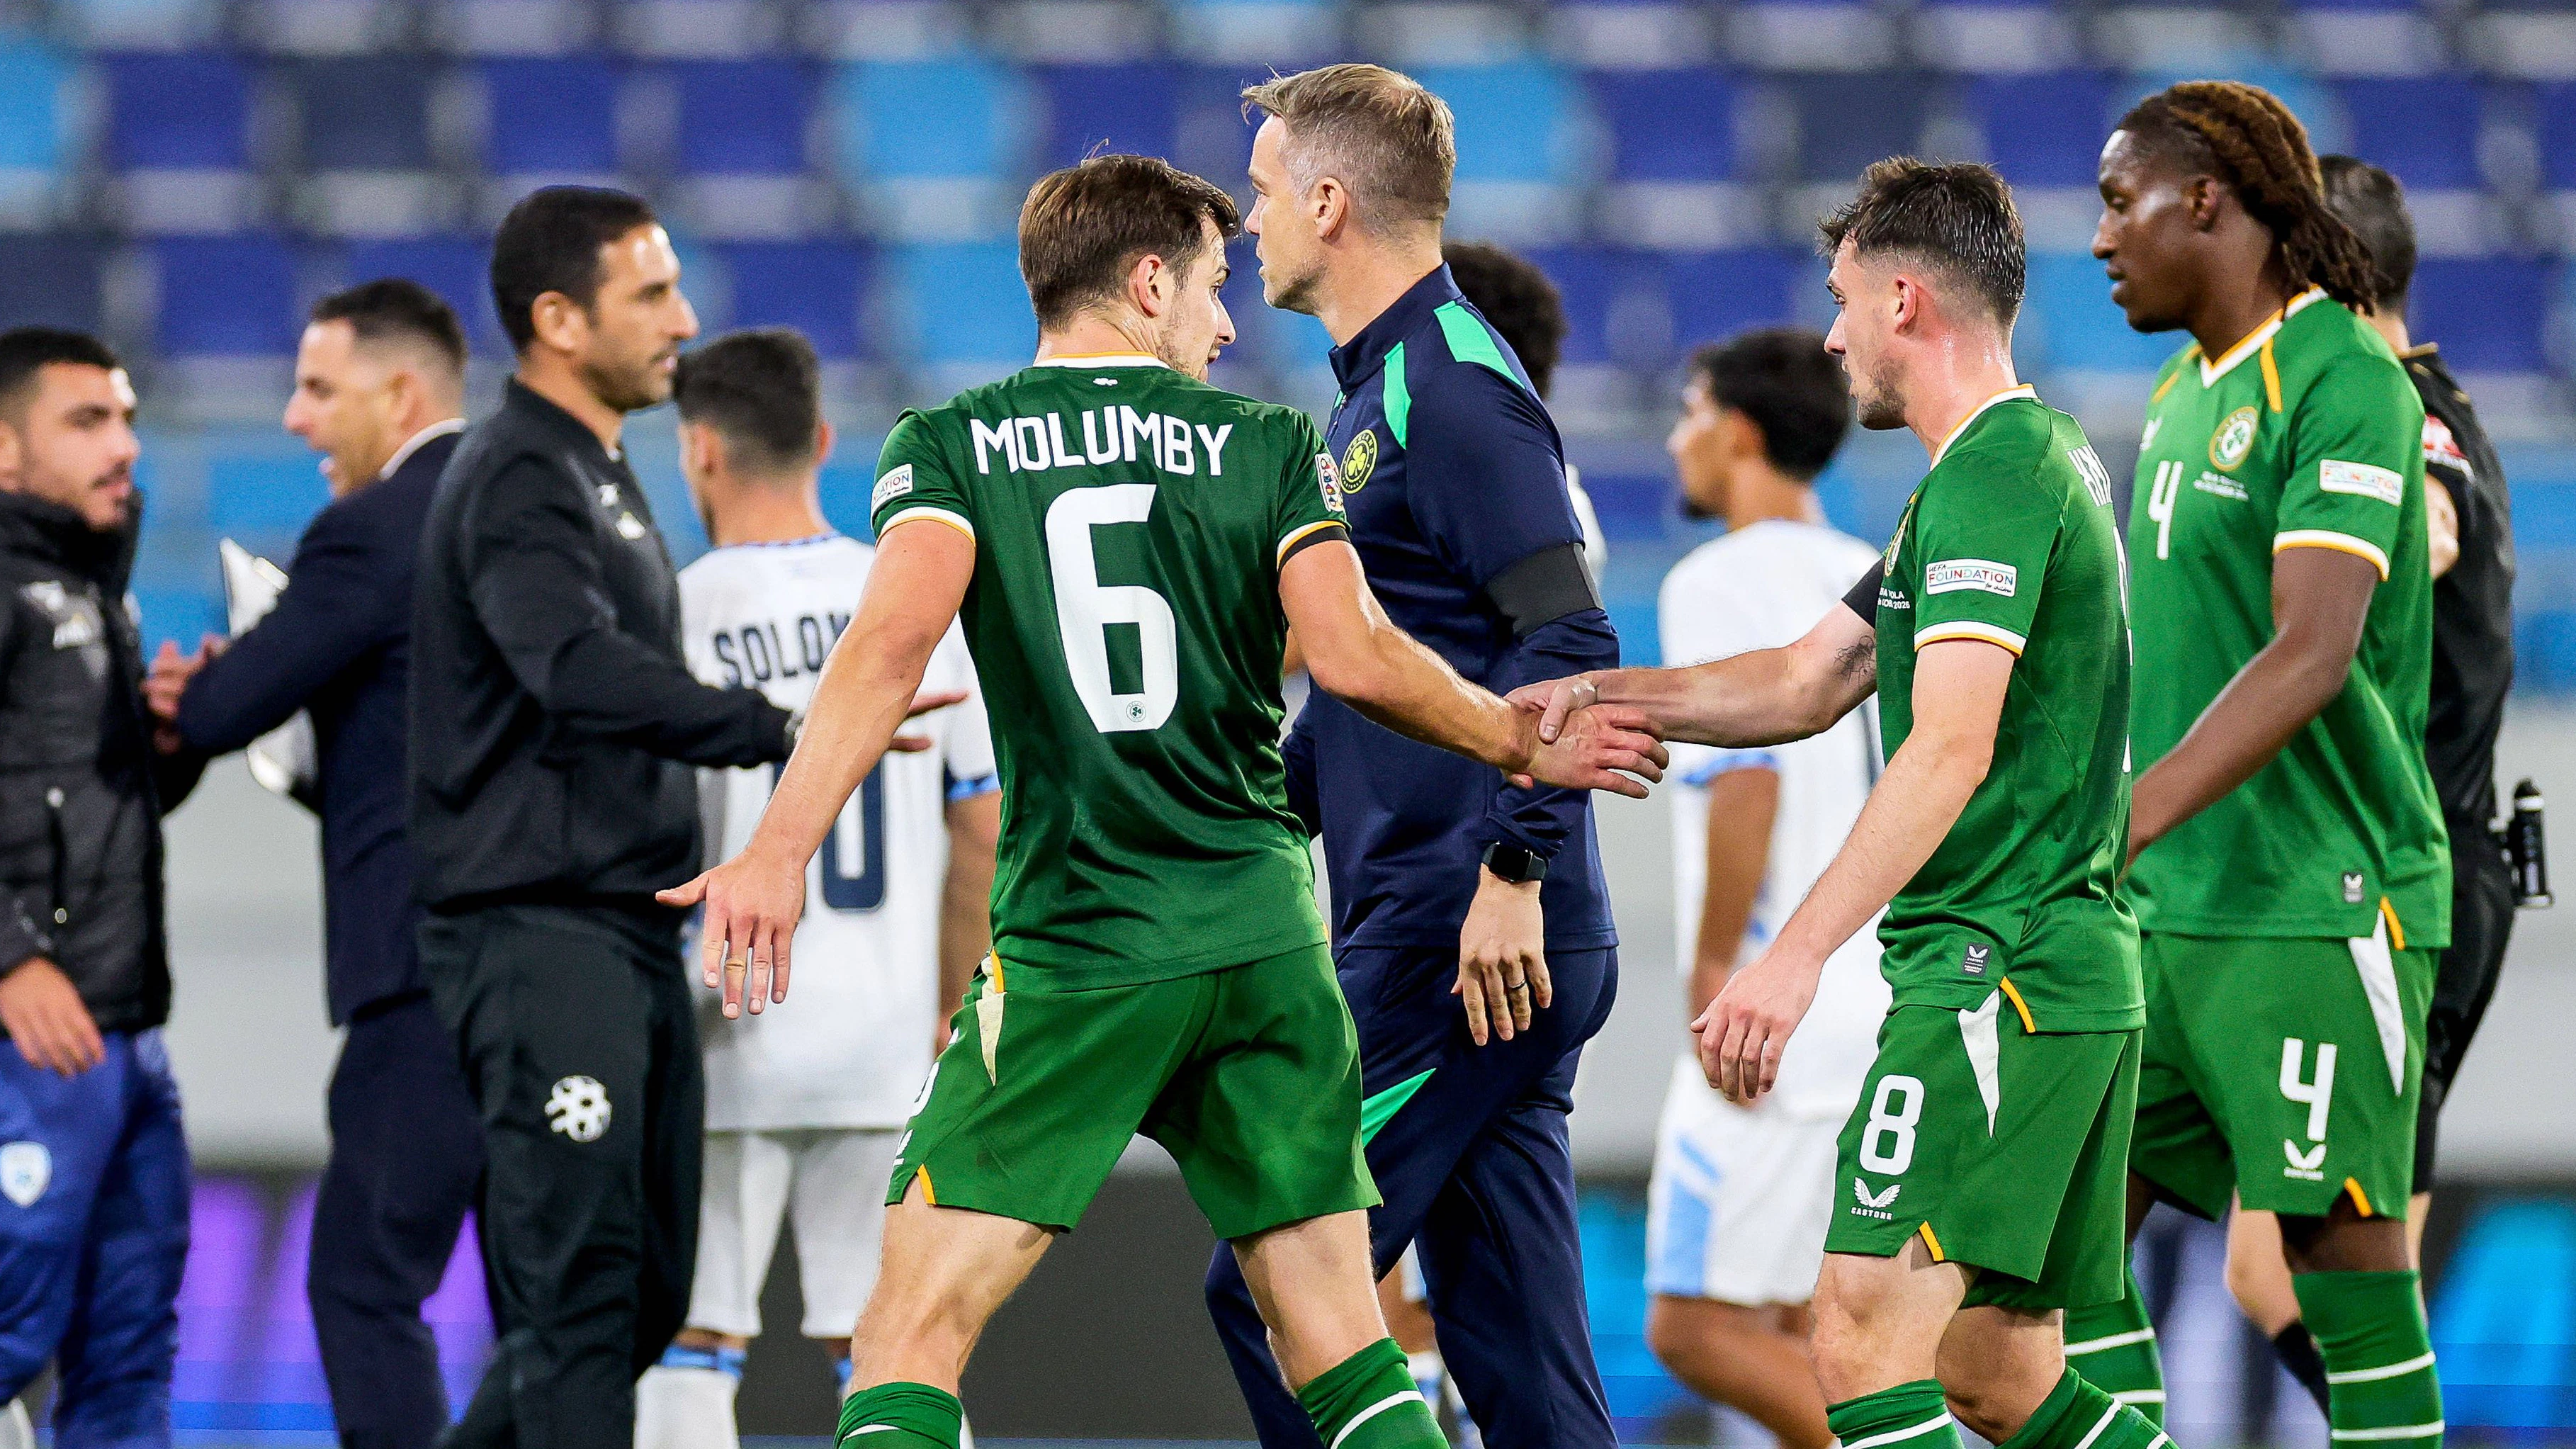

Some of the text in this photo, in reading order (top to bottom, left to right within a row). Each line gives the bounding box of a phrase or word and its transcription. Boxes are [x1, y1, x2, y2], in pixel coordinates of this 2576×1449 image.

[969, 405, 1233, 476] MOLUMBY
[2147, 460, 2184, 560] 4
[1044, 483, 1178, 733] 6
[1928, 564, 1946, 573] UEFA
[1928, 568, 2013, 585] FOUNDATION
[1859, 1074, 1925, 1175] 8
[2278, 1037, 2337, 1141] 4
[1851, 1207, 1893, 1221] CASTORE
